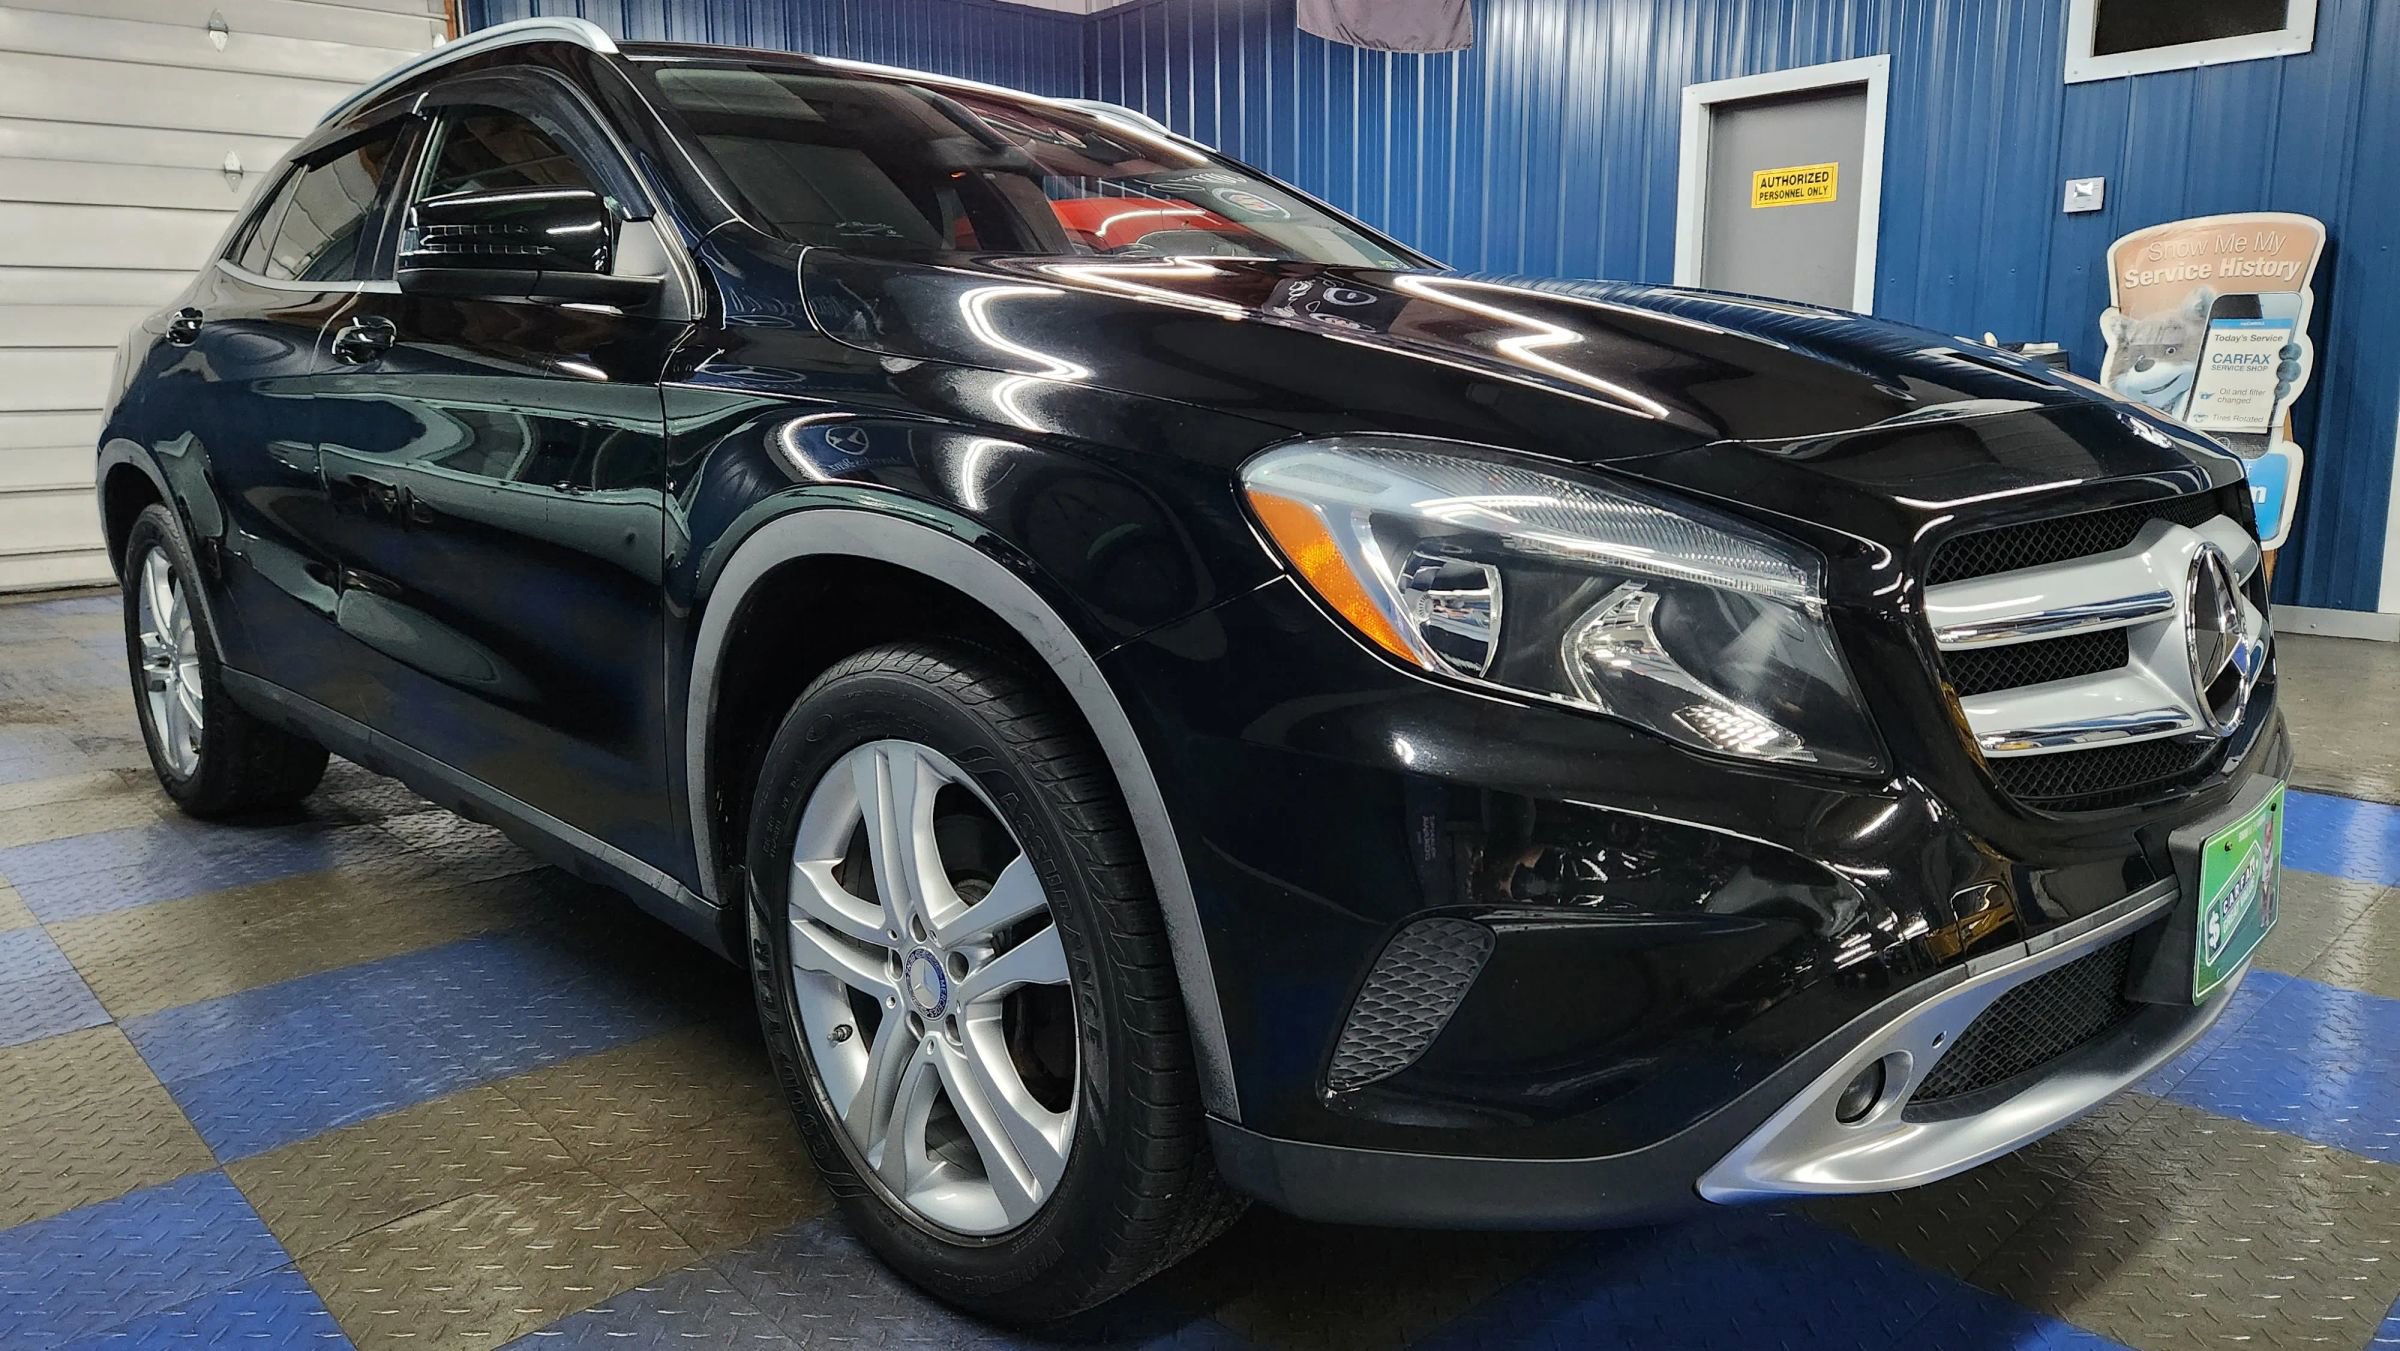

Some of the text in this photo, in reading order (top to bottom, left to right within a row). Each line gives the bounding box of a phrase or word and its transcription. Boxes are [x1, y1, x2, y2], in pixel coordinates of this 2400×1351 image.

[1760, 171, 1829, 189] AUTHORIZED
[1759, 185, 1829, 201] PERSONNEL ONLY
[2148, 231, 2287, 262] Show Me My
[2124, 256, 2302, 289] Service History
[2214, 334, 2284, 343] Today's Service
[2212, 352, 2272, 365] CARFAX
[2210, 364, 2269, 372] SERVICE SHOP
[2219, 387, 2267, 396] Oil and filter
[2217, 396, 2252, 405] changed
[2232, 414, 2265, 423] Rotated
